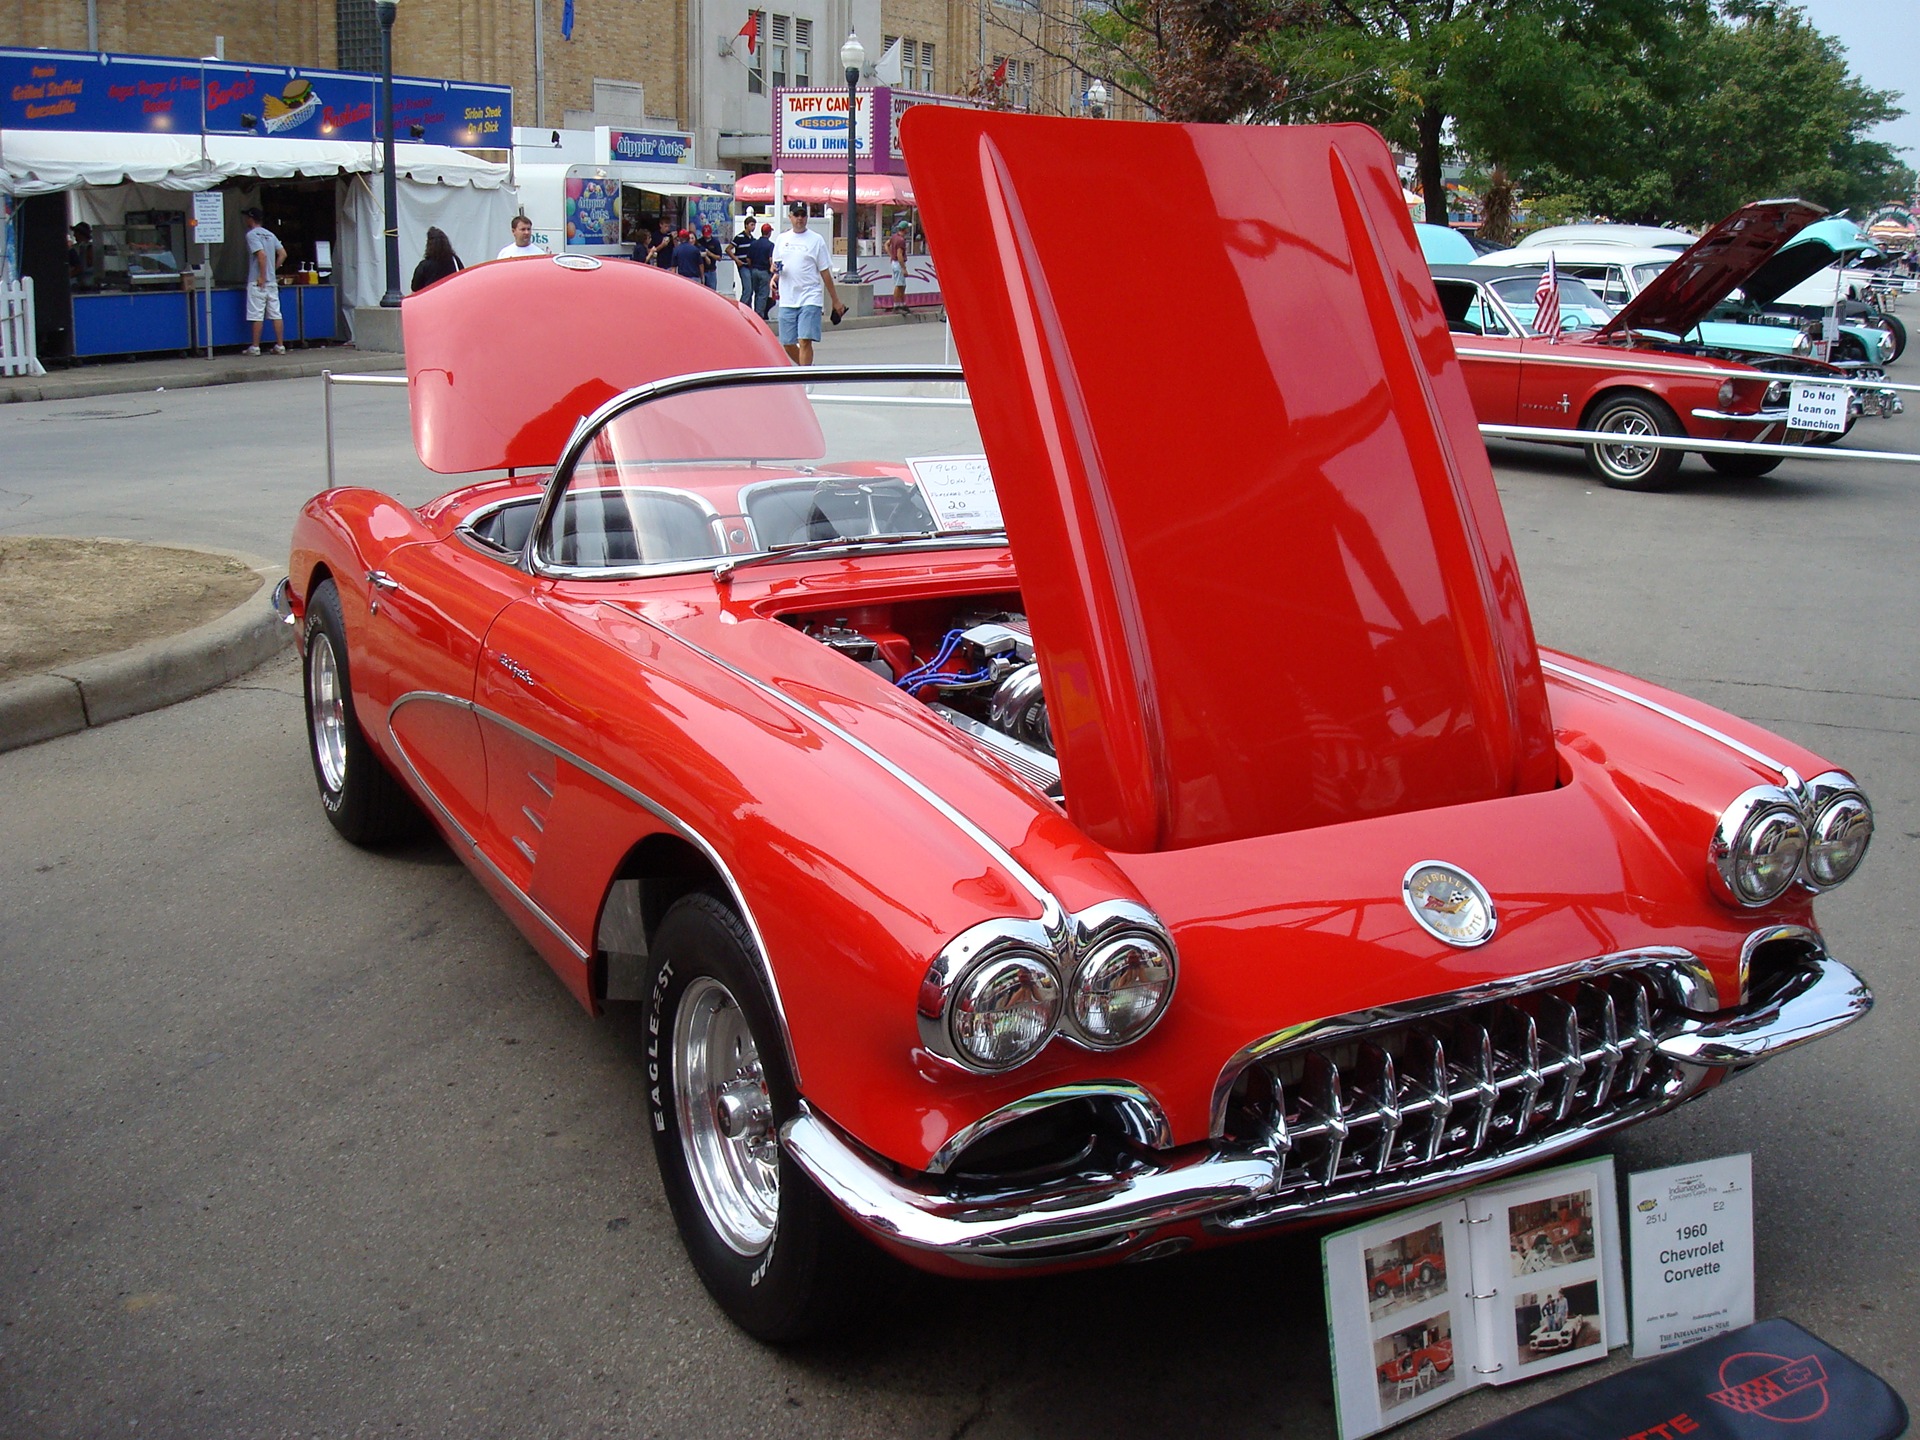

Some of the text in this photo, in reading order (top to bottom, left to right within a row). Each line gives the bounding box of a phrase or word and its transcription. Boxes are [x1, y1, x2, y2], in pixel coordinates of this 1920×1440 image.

[47, 79, 84, 97] Stuffed
[789, 97, 863, 112] TAFFY CANY
[464, 105, 502, 120] Sirloin Steak
[477, 122, 483, 133] A
[484, 120, 499, 133] Stick
[617, 136, 657, 157] dippin'
[788, 137, 863, 150] COLD DRINS
[742, 185, 771, 195] Popcorn
[1802, 389, 1835, 402] Do Not
[1797, 403, 1836, 416] Lean on
[1791, 416, 1840, 431] Stanchion
[929, 463, 957, 472] 1960
[948, 500, 966, 510] 20
[1414, 872, 1470, 899] CHEVROLET
[658, 958, 675, 989] ST
[648, 1013, 666, 1132] EAGLE
[1668, 1181, 1706, 1195] Indianapolis
[1713, 1201, 1725, 1211] E2
[1646, 1212, 1667, 1225] 251J
[1676, 1223, 1708, 1241] 1960
[1660, 1240, 1724, 1264] Chevrolet
[1664, 1262, 1721, 1283] Corvette
[1660, 1333, 1672, 1342] THE
[1673, 1325, 1714, 1339] INDIANAPOLIS
[1715, 1321, 1730, 1329] STAR
